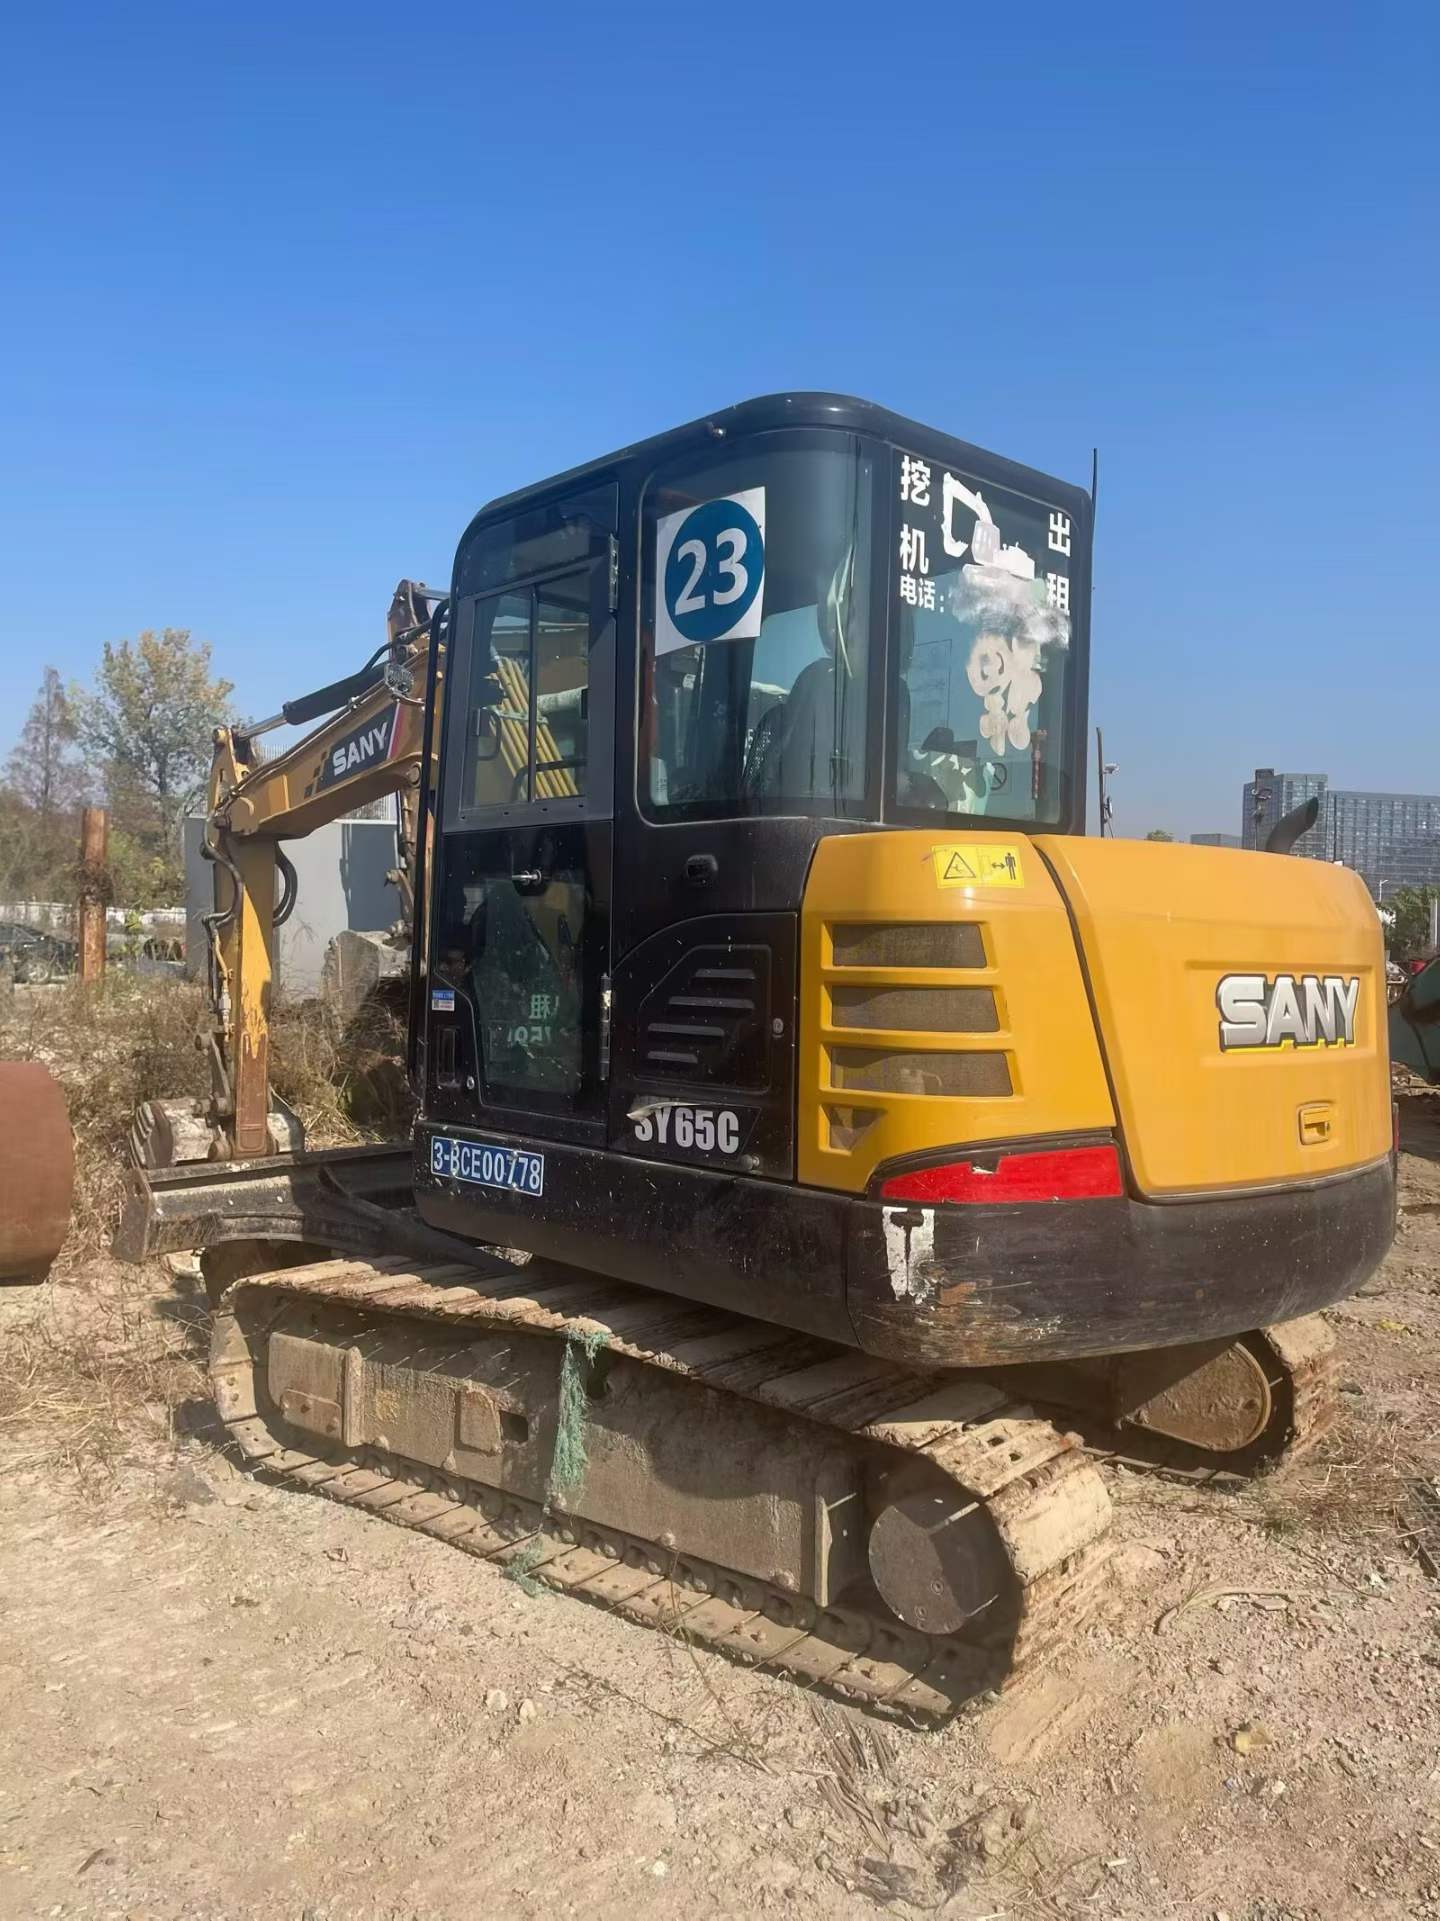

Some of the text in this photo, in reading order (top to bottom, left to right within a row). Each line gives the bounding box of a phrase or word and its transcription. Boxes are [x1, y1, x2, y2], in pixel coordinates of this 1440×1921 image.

[900, 455, 931, 575] 挖机
[675, 527, 749, 616] 23
[332, 721, 388, 776] SANY
[1216, 974, 1359, 1050] SANY
[433, 1142, 541, 1190] 3-BCE00778
